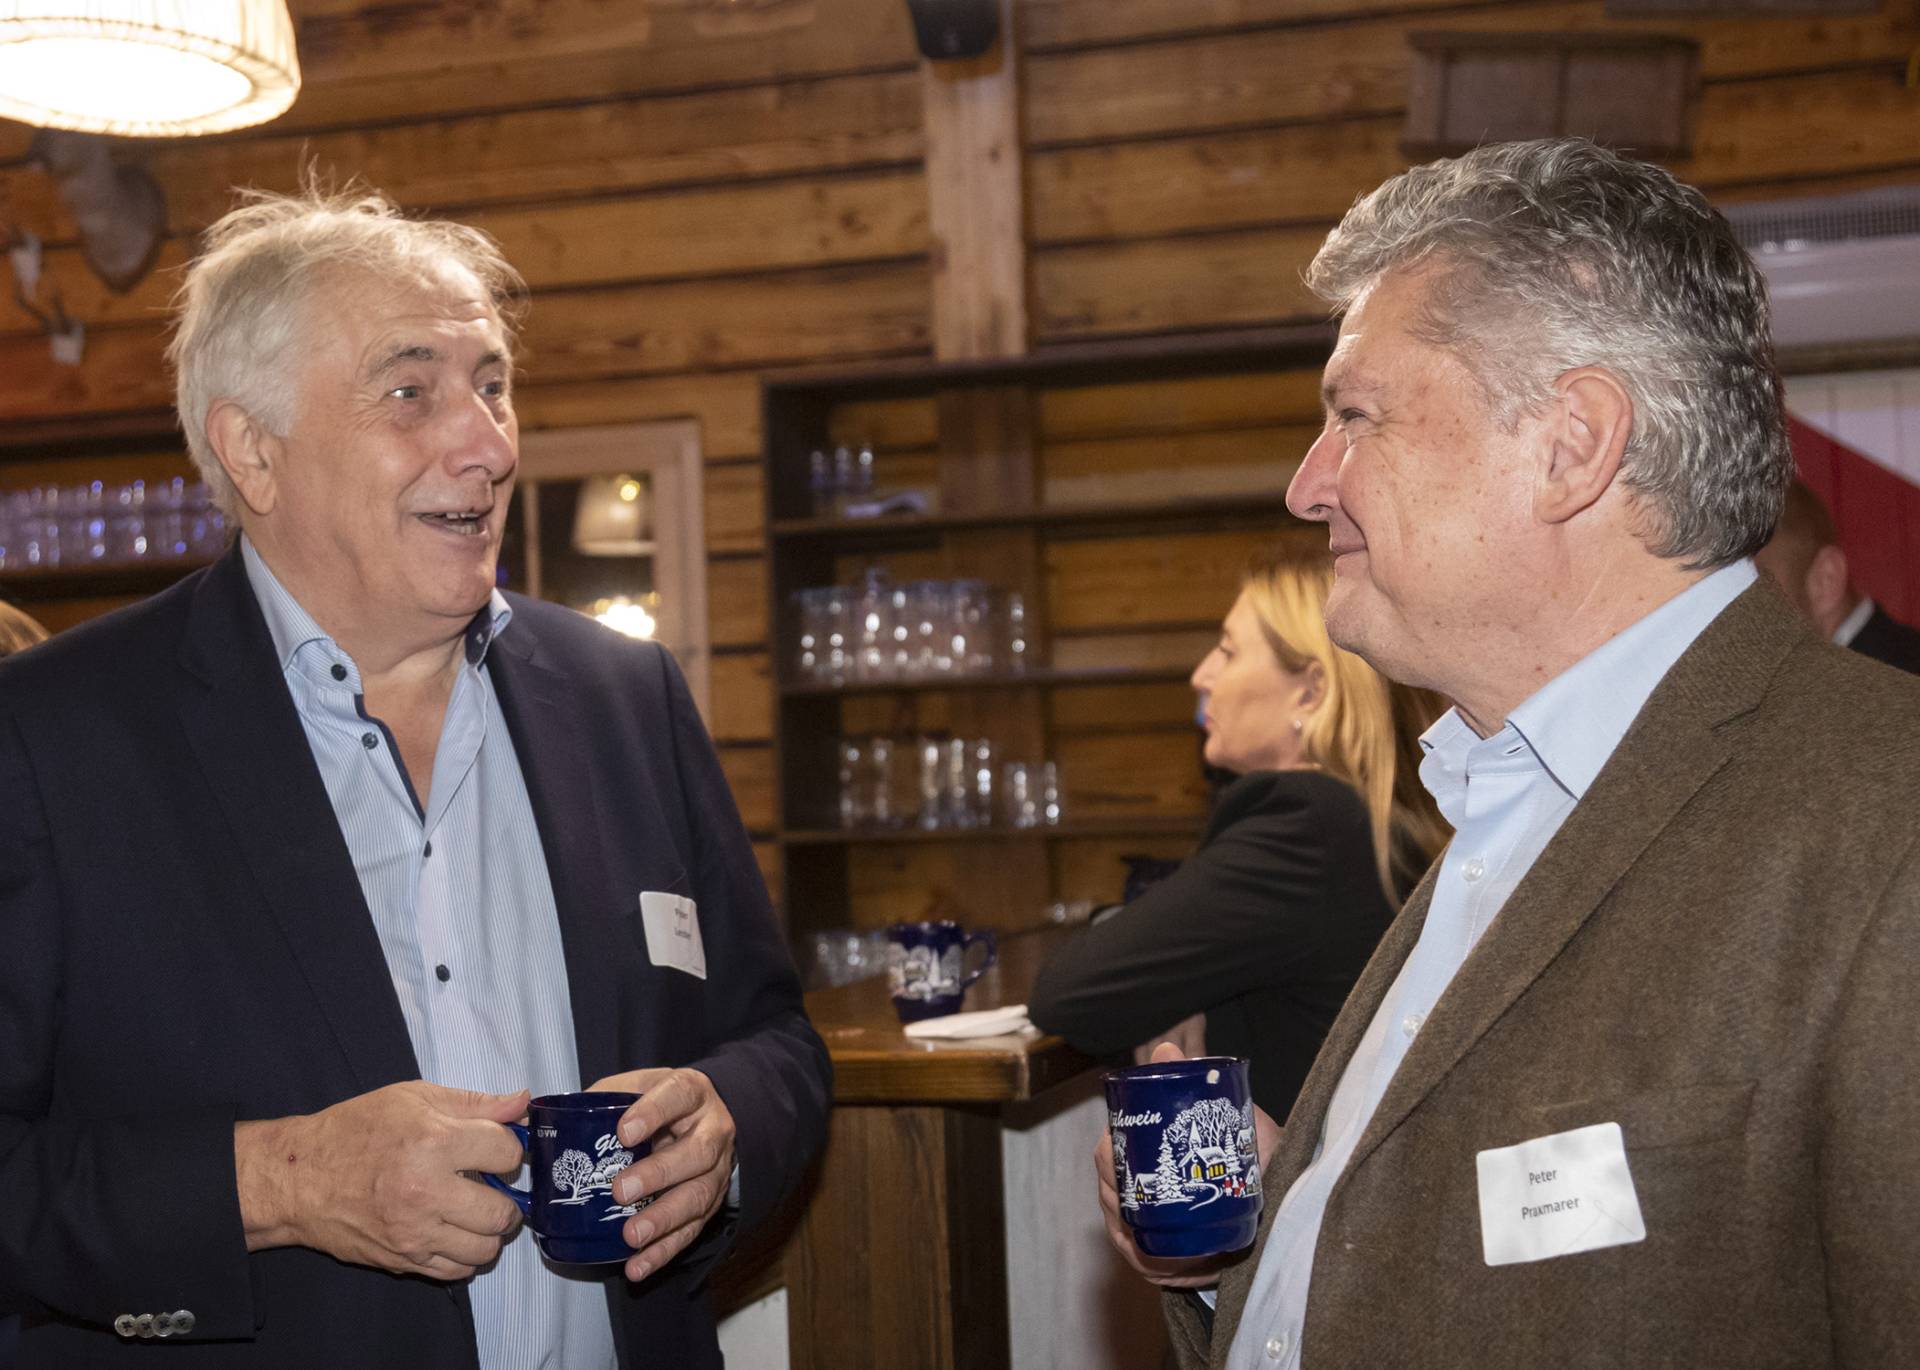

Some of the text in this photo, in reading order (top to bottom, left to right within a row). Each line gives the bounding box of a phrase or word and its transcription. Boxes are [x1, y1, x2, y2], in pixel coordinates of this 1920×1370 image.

[1110, 1109, 1163, 1128] lühwein
[1529, 1169, 1557, 1185] Peter
[1521, 1198, 1579, 1220] Praxmarer
